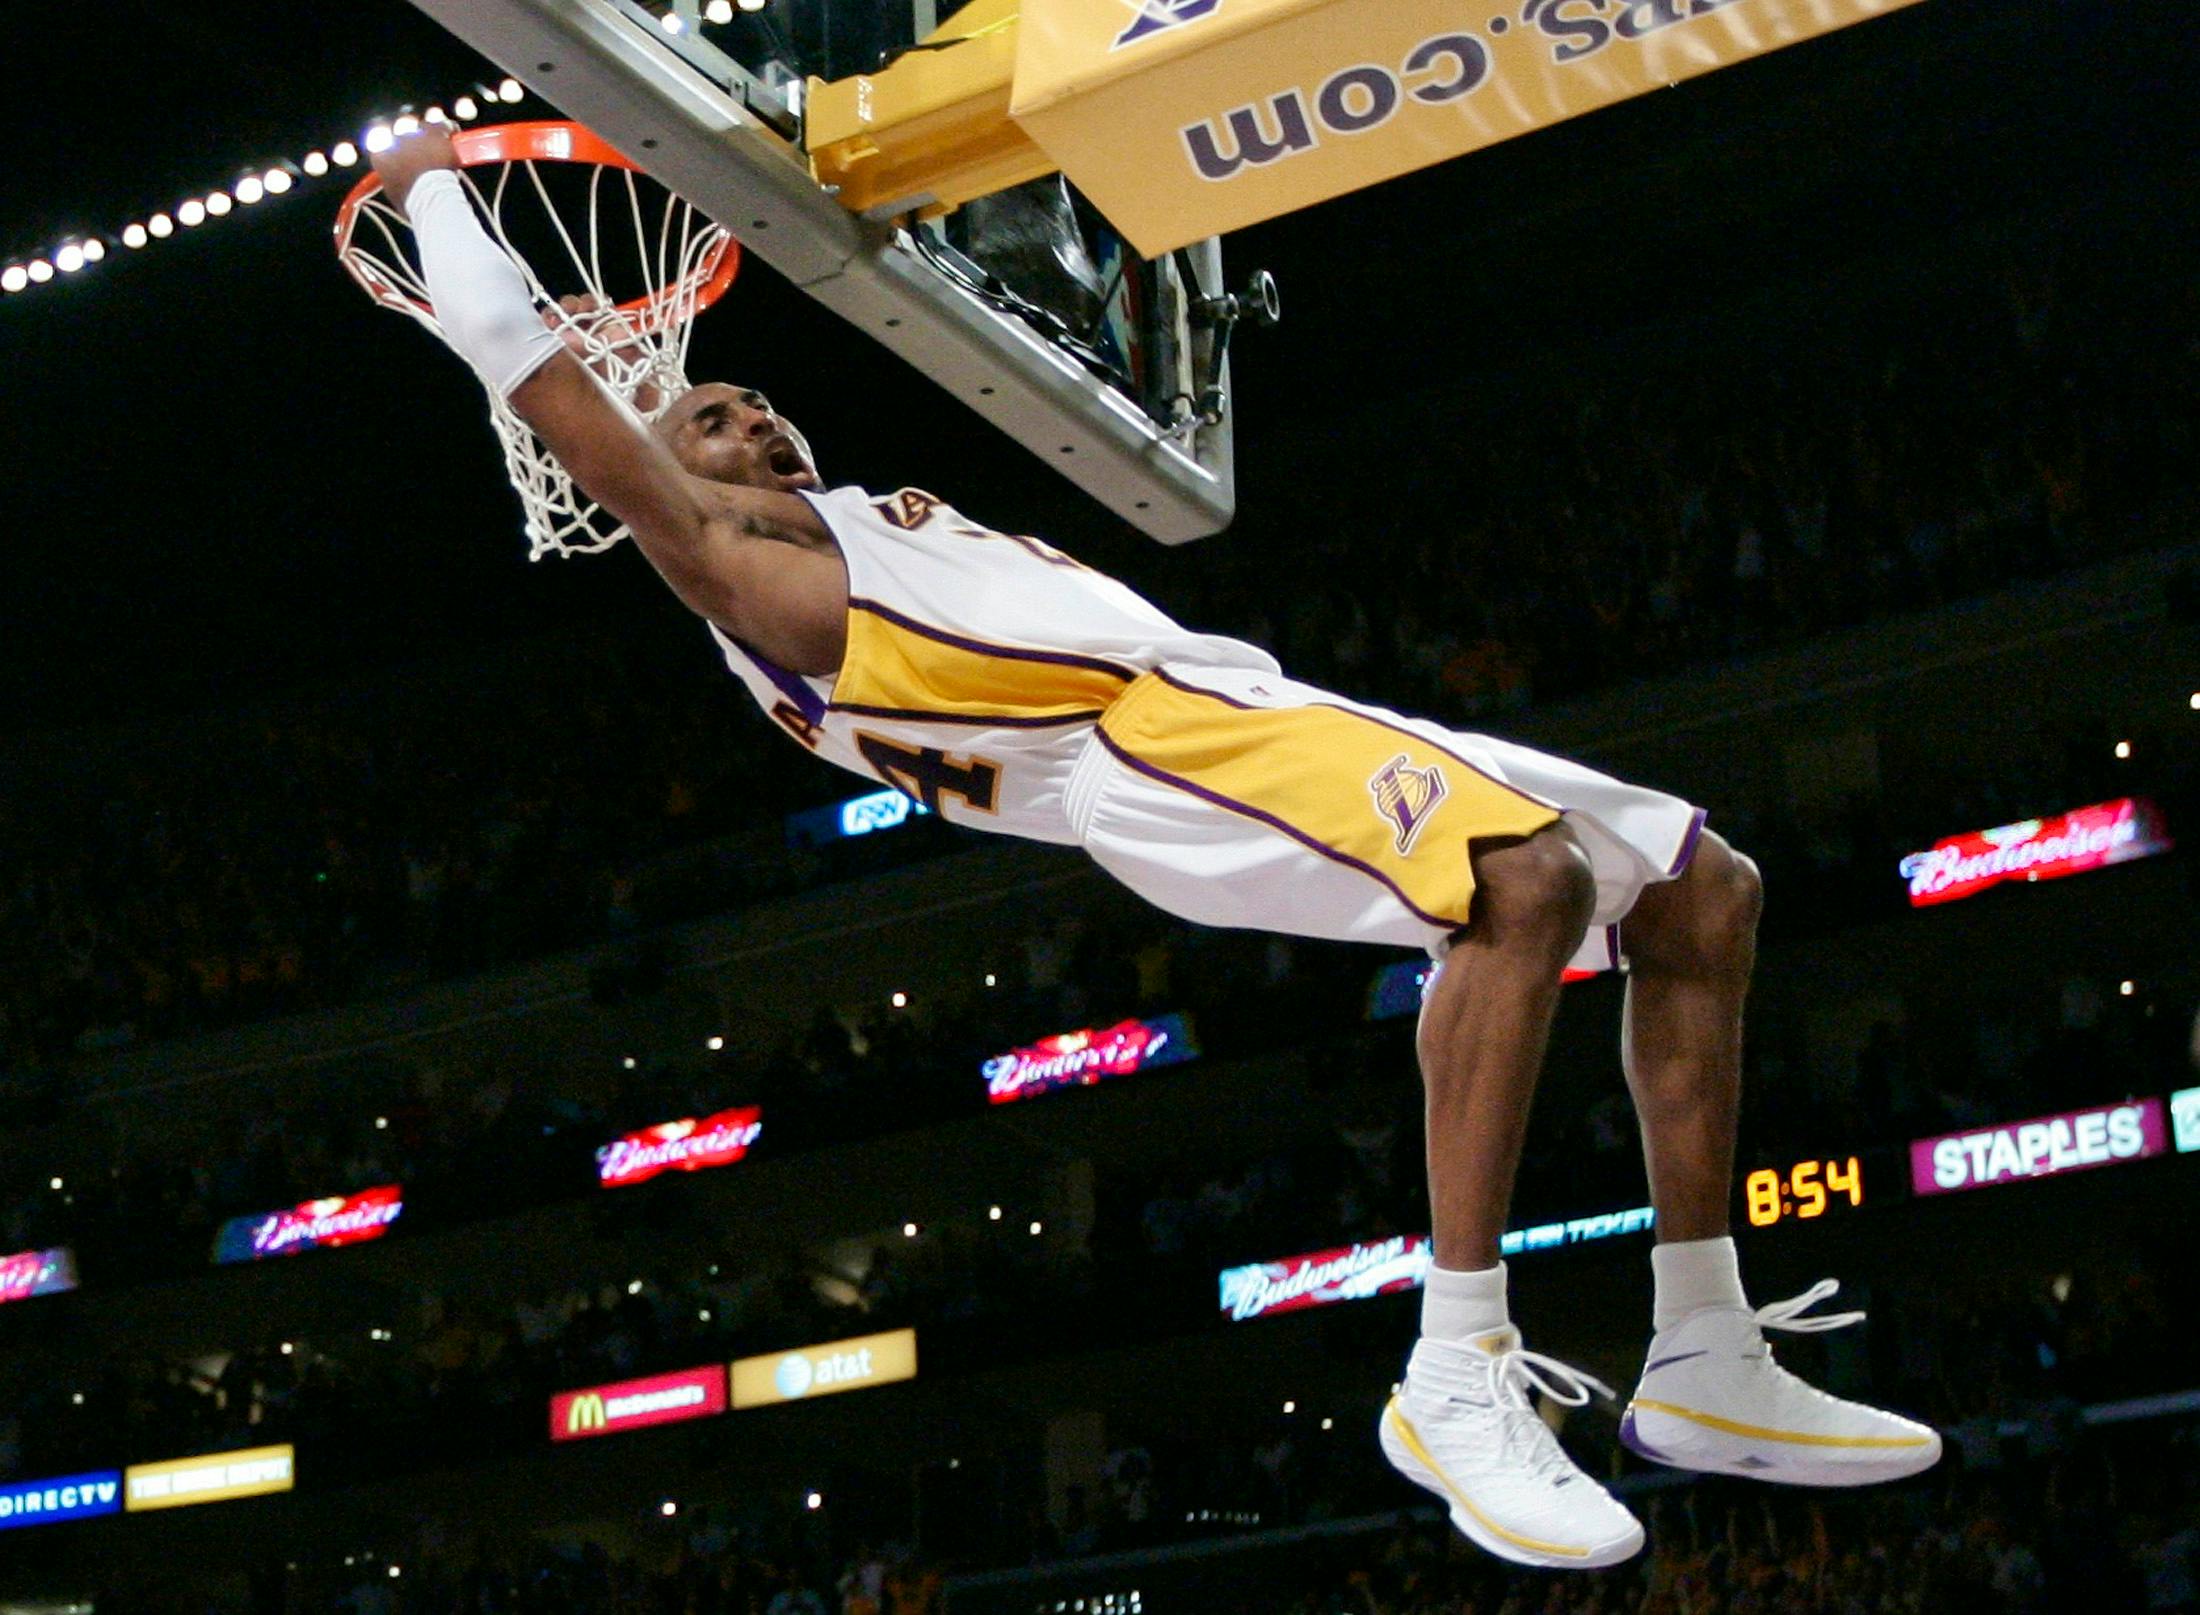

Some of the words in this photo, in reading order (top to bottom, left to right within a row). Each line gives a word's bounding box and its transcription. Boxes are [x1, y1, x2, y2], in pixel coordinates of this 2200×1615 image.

[1933, 1106, 2144, 1188] STAPLES
[1746, 1157, 1862, 1227] 8:54
[1228, 1235, 1406, 1322] Budweiser
[0, 1481, 117, 1518] DIRECTV
